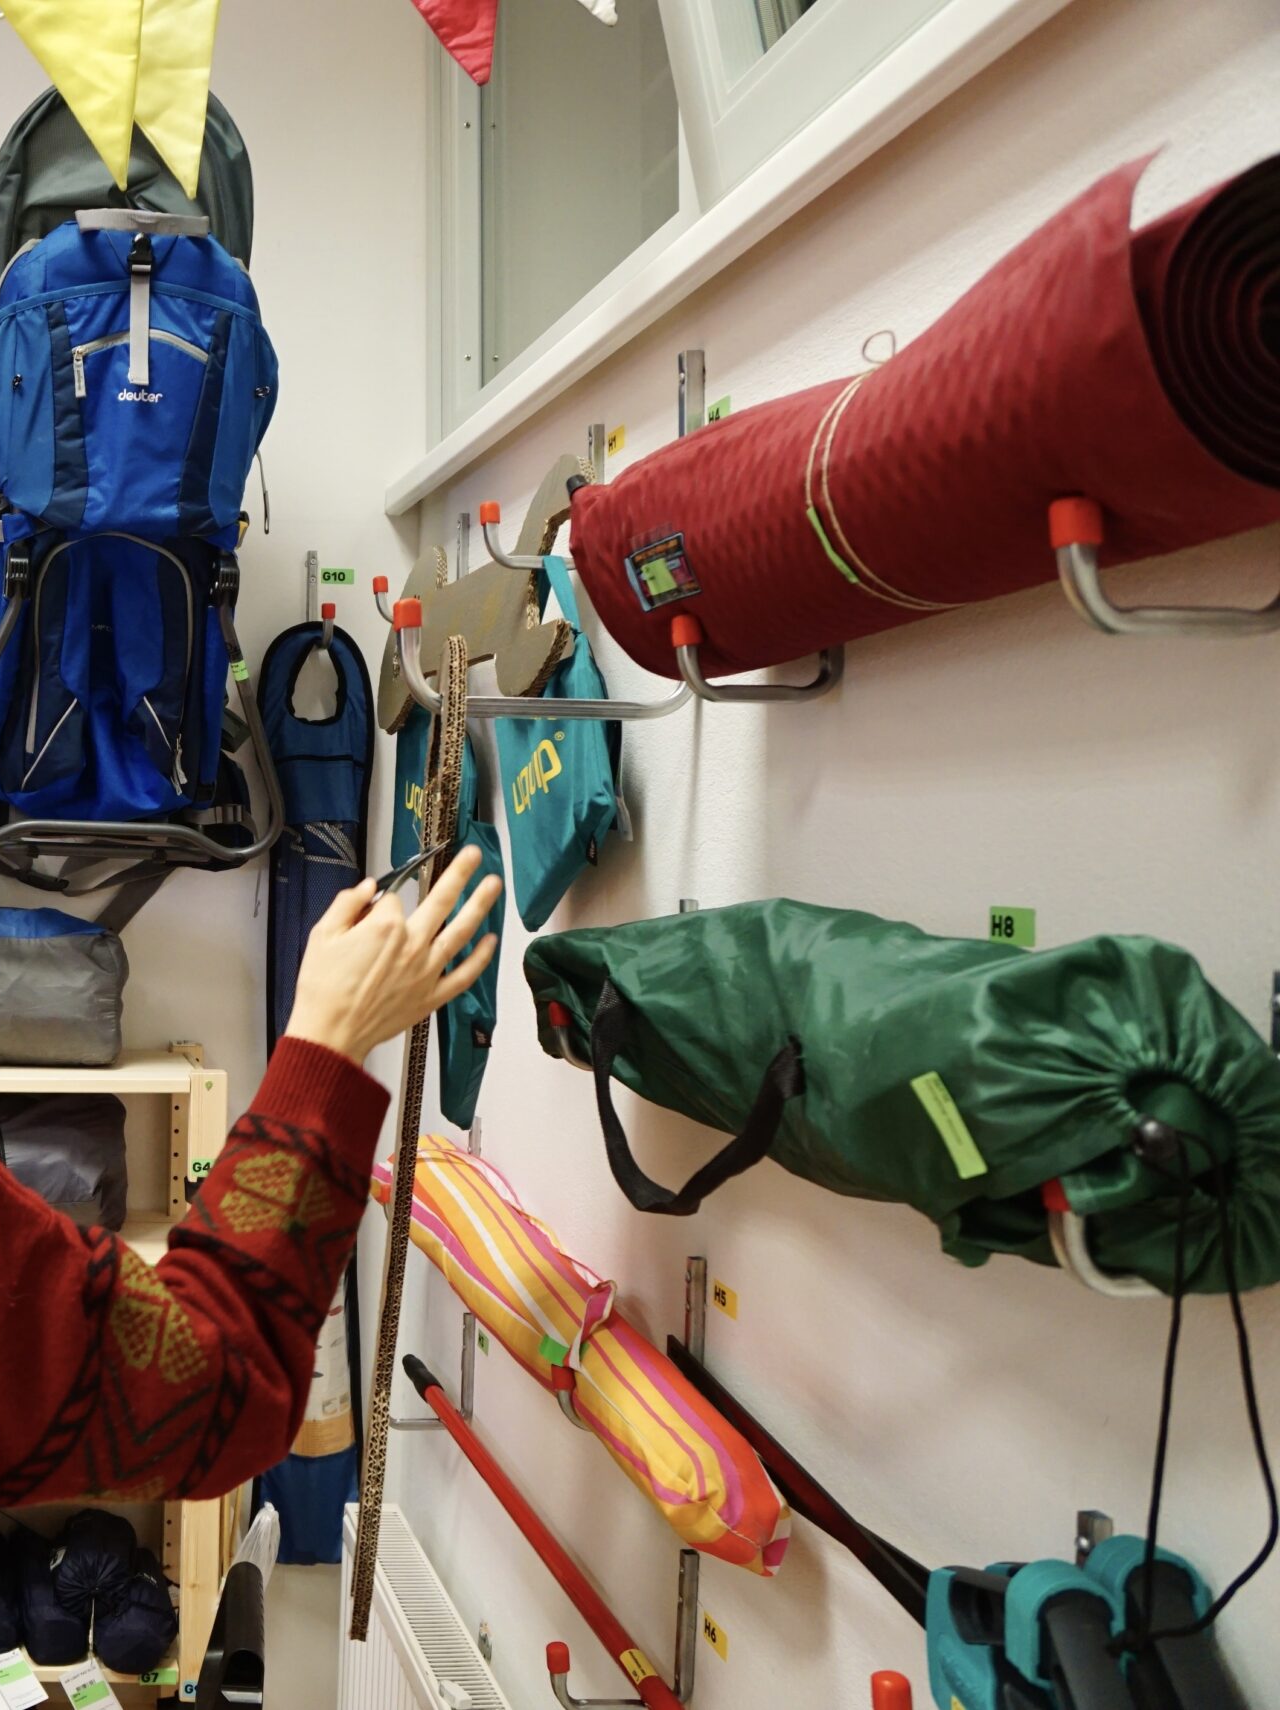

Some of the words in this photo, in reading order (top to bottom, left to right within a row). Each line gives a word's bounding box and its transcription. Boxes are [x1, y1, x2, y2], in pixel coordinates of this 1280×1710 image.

[118, 388, 163, 403] deuter
[608, 434, 617, 453] H1
[322, 571, 346, 582] G10
[991, 914, 1015, 939] H8
[192, 1161, 211, 1173] G4
[714, 1284, 727, 1307] H5
[704, 1617, 717, 1644] H6
[141, 1671, 160, 1683] G7
